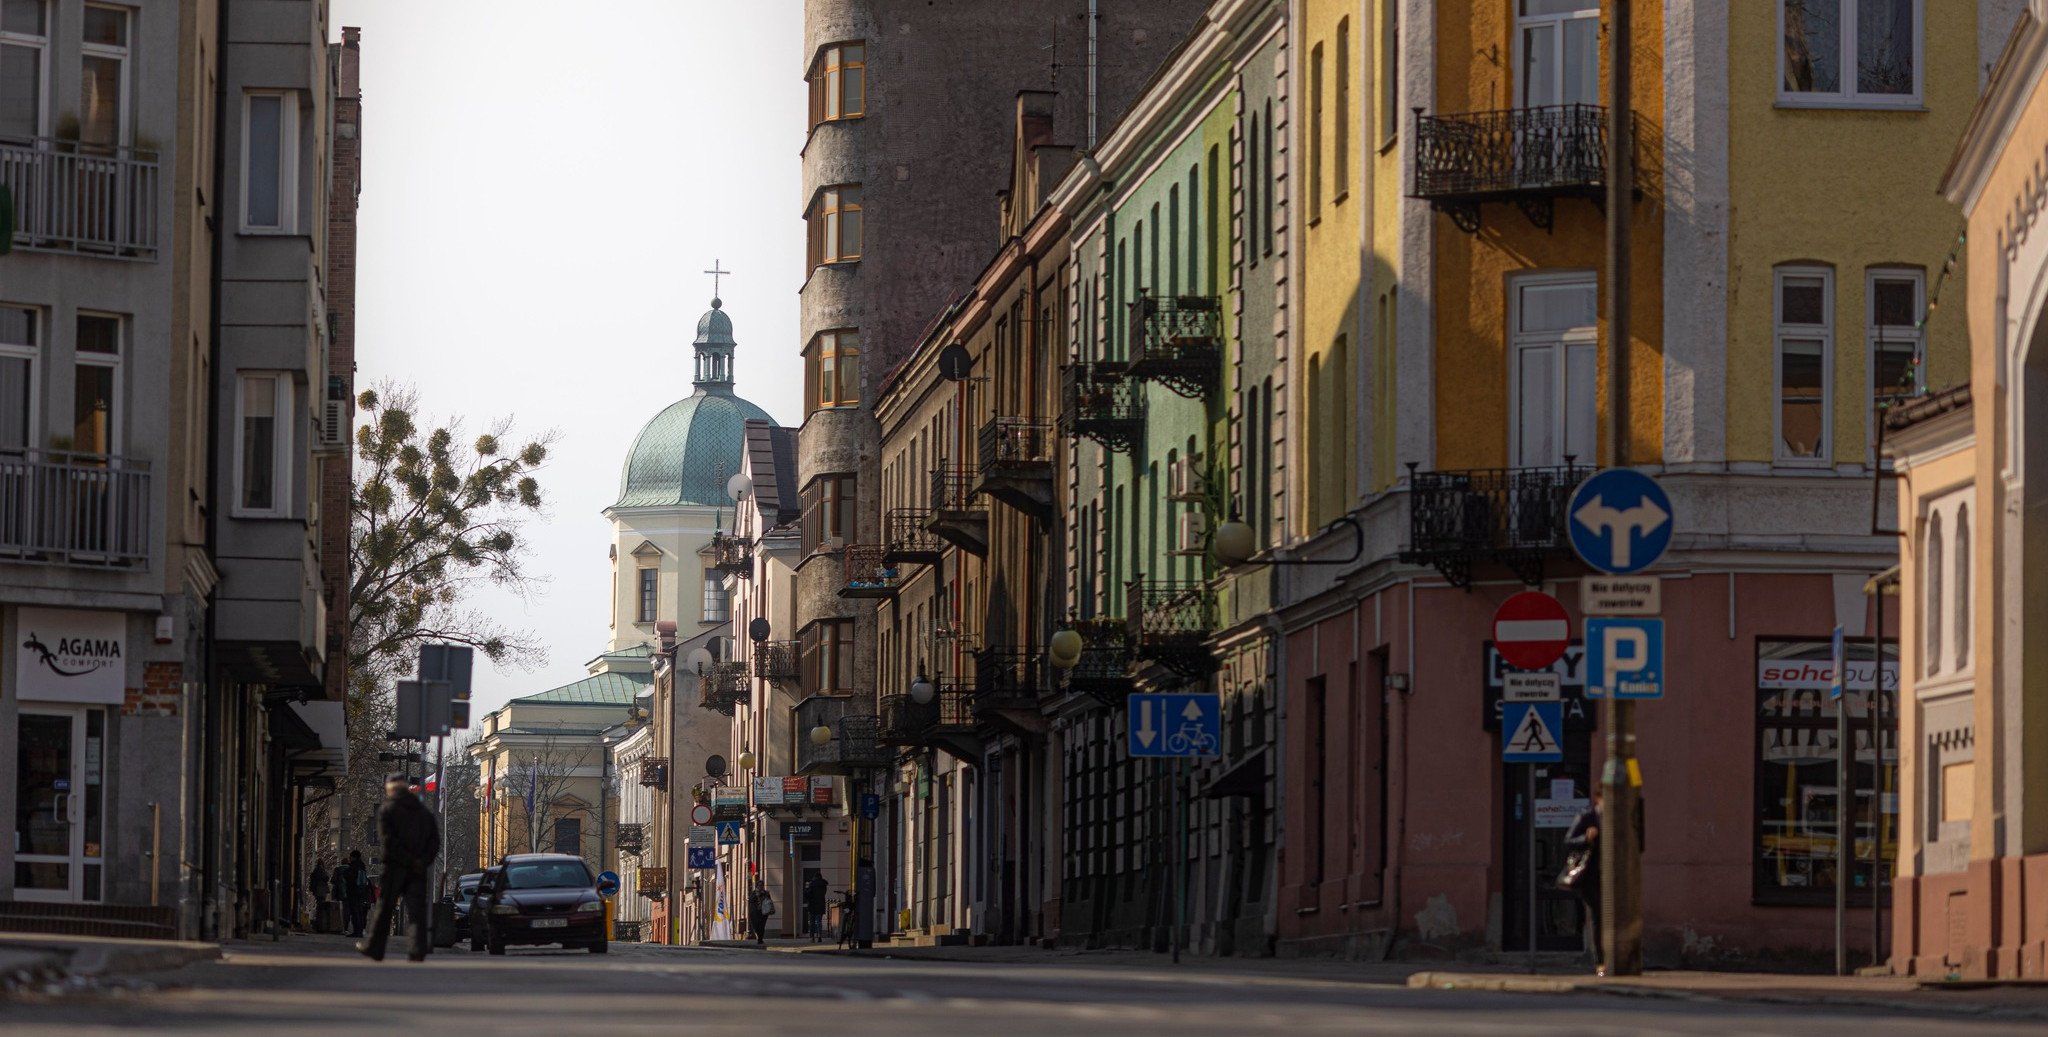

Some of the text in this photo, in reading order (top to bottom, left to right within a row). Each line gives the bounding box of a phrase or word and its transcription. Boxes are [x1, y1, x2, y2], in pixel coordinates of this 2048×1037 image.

[1592, 583, 1652, 593] Nie dotyczy
[58, 638, 121, 658] AGAMA
[1604, 626, 1648, 688] P
[62, 659, 114, 668] COMFORT
[1525, 679, 1554, 687] dotyczy
